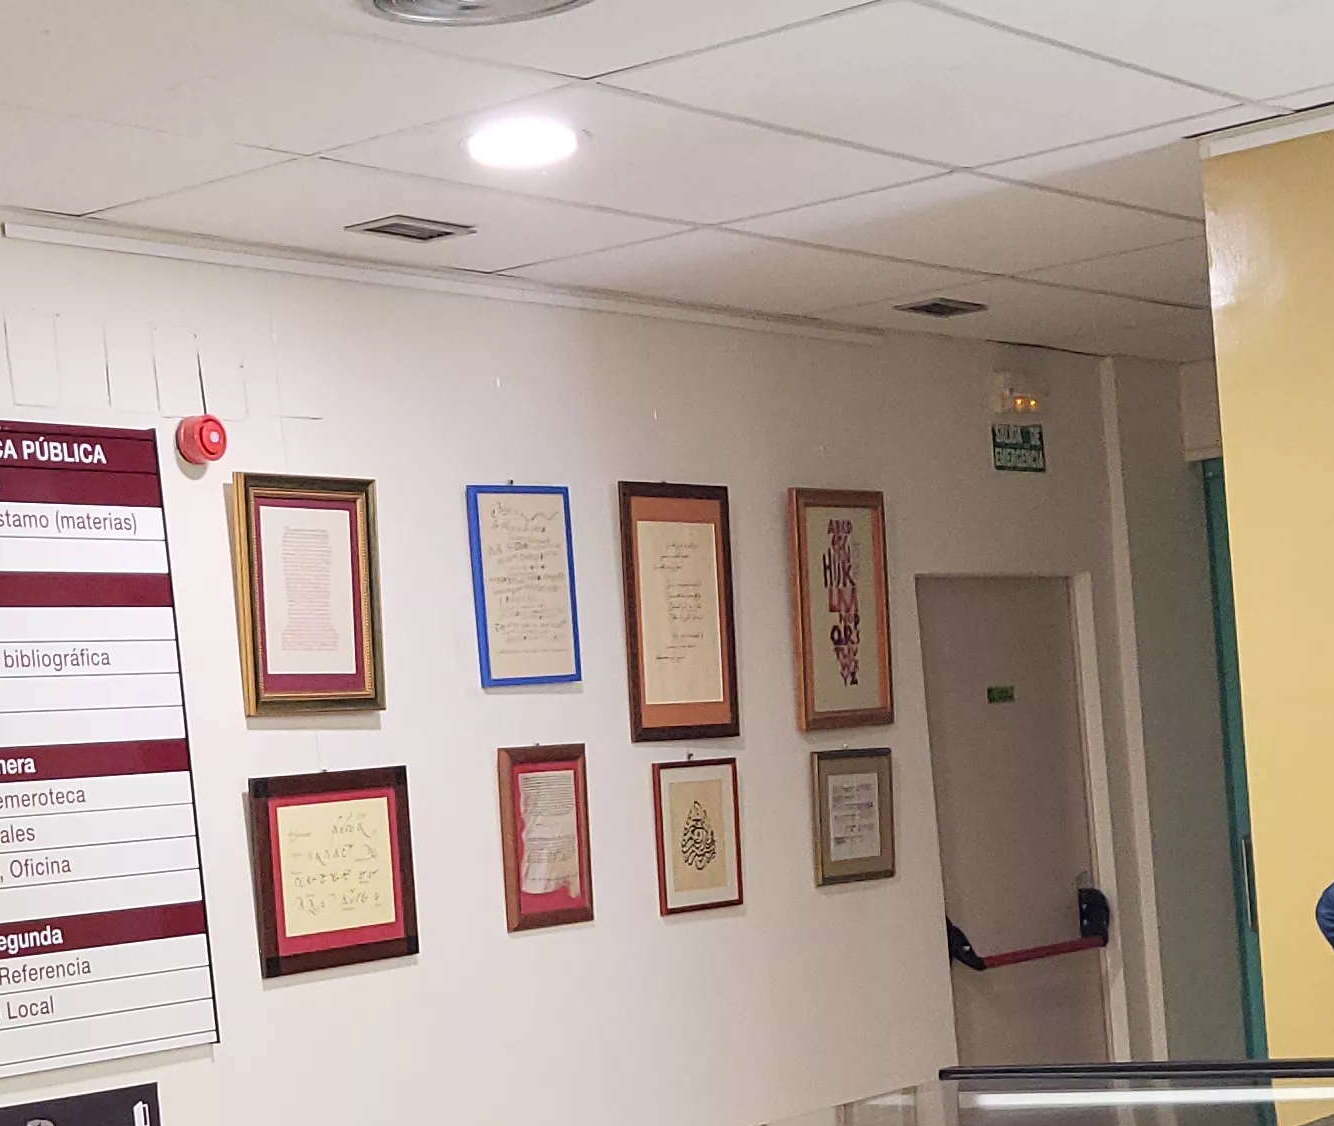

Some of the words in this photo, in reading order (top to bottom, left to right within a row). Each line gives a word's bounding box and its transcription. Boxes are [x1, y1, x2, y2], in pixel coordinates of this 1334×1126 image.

[22, 436, 106, 464] PÚBLICA
[55, 511, 137, 535] (materias)
[4, 648, 111, 671] bibliográfica
[10, 857, 71, 878] Oficina
[0, 957, 91, 986] Referencia
[8, 995, 54, 1021] Local
